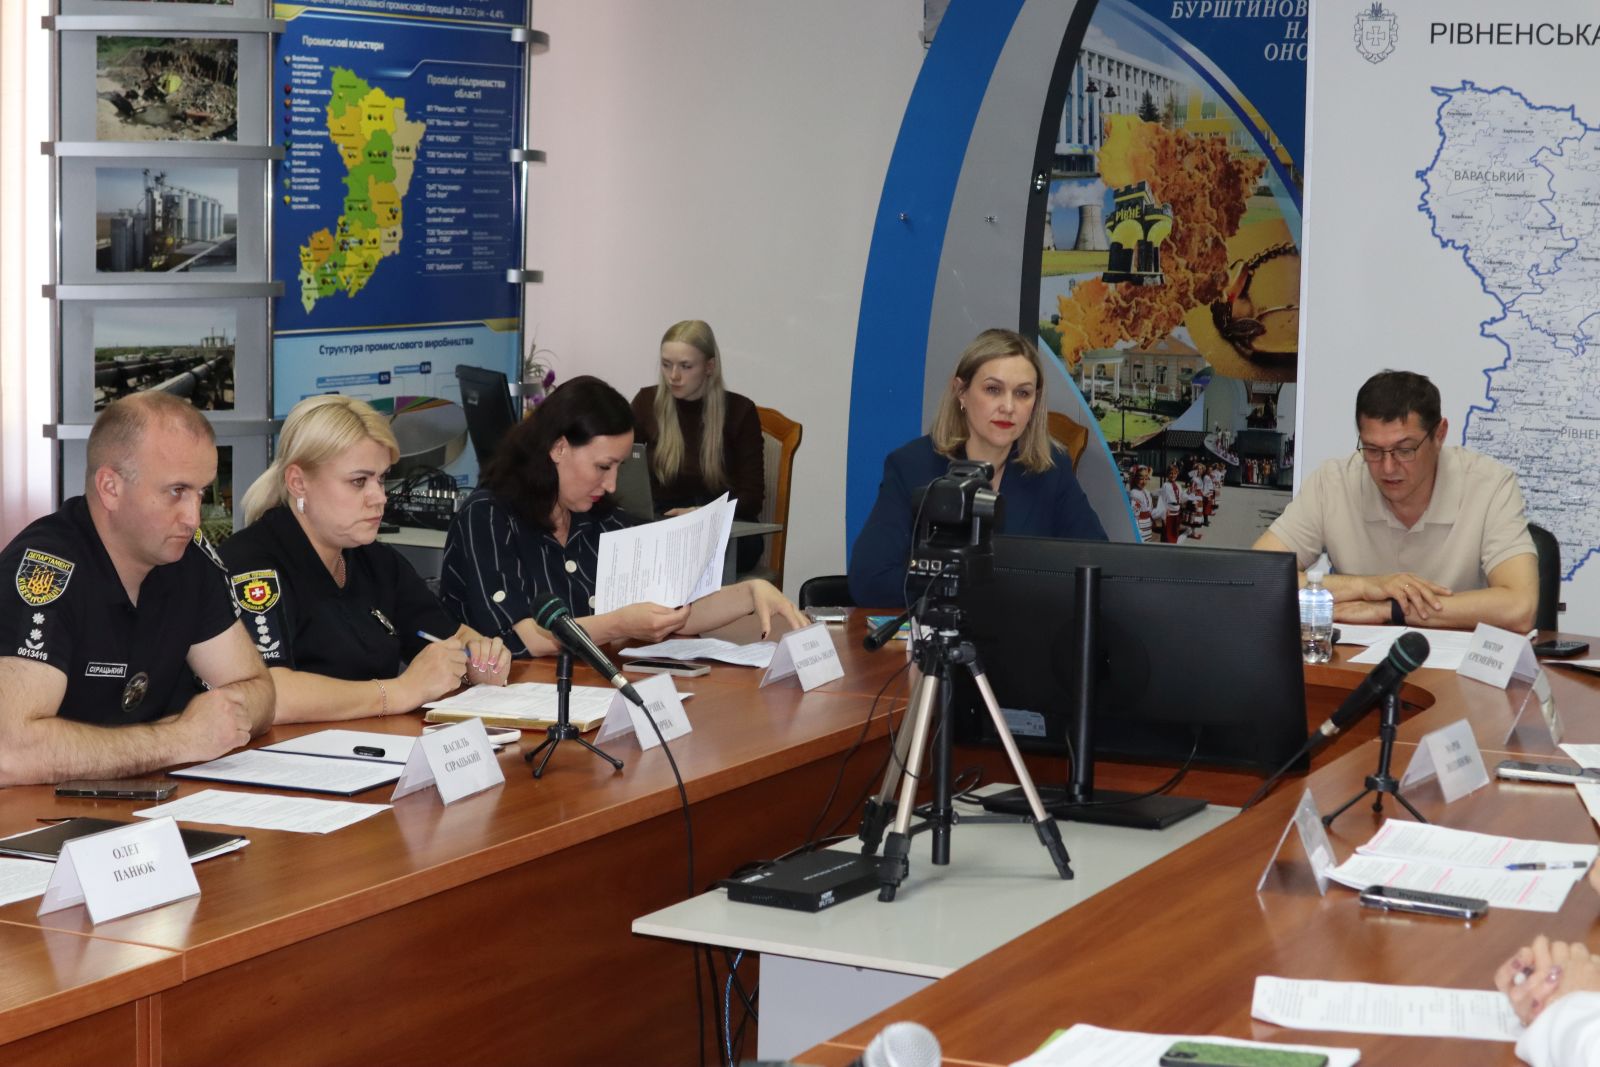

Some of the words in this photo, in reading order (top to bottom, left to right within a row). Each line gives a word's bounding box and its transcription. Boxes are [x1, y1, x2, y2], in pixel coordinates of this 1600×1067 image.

[1454, 168, 1525, 182] ВАРАСЬКИЙ
[319, 343, 364, 356] Структура
[364, 340, 423, 354] промислового
[424, 336, 474, 349] виробництва
[27, 551, 72, 571] ДЕПАРТАМЕНТ
[112, 842, 141, 860] ОЛЕГ
[113, 860, 157, 882] ПАНЮК
